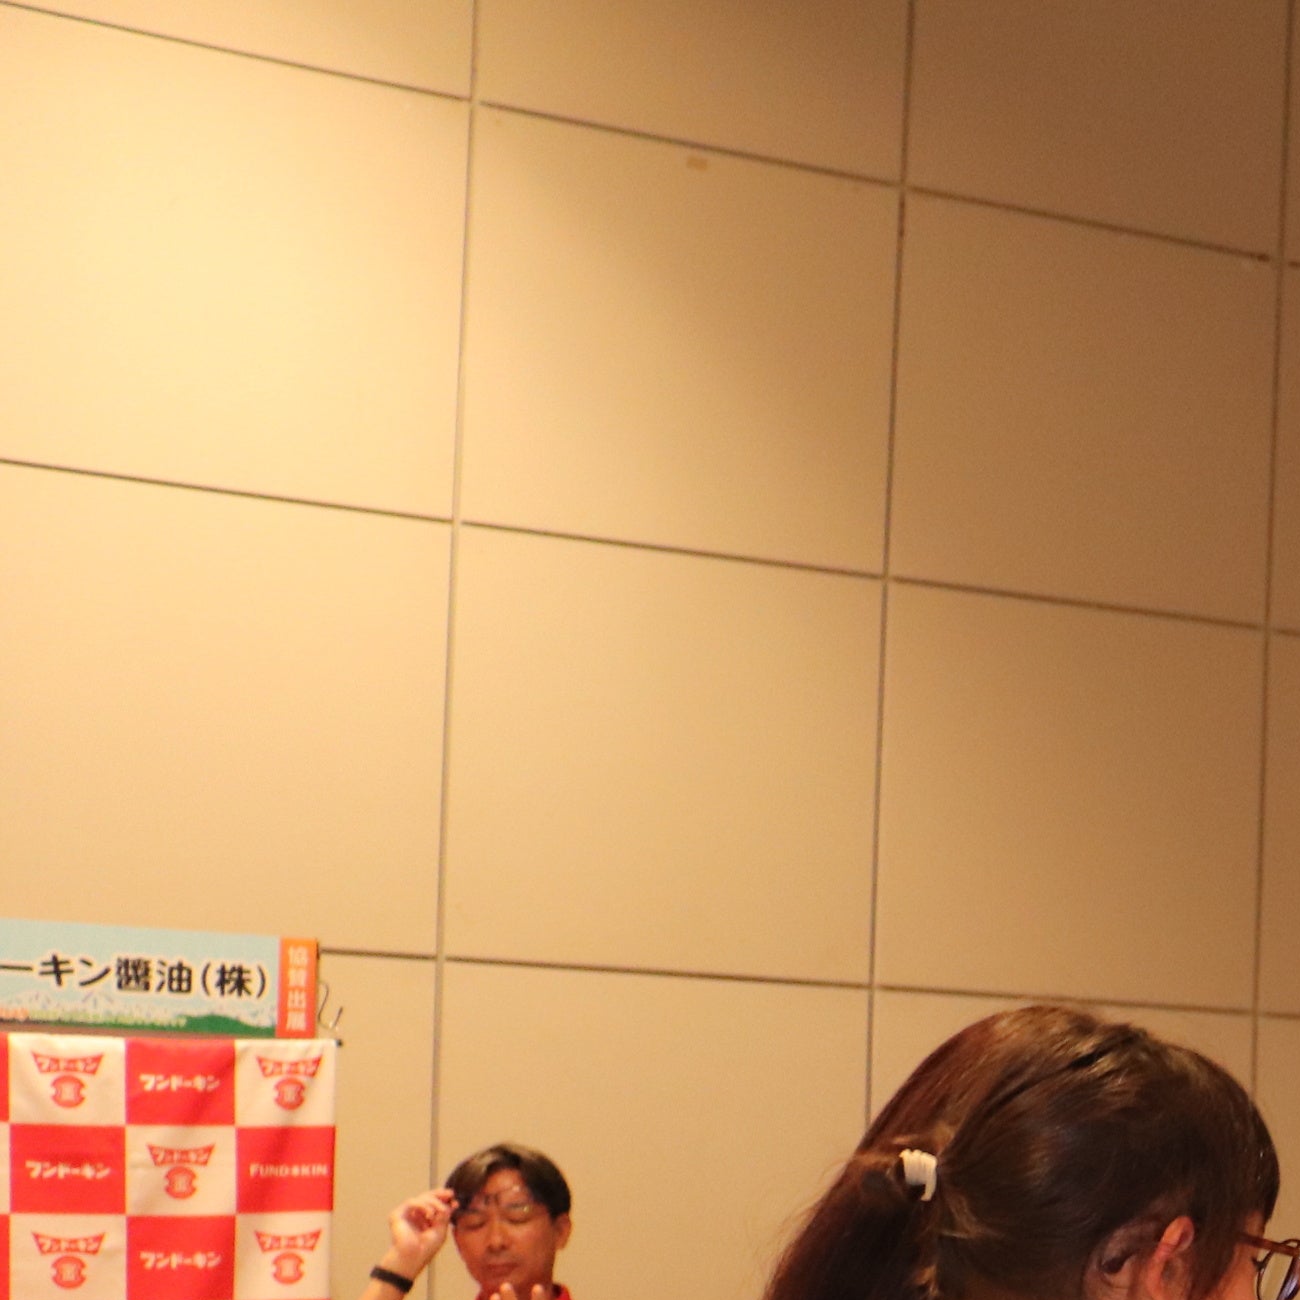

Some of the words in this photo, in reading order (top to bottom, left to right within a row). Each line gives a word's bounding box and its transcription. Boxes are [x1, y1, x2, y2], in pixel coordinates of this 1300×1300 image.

[140, 1073, 221, 1092] フンドーキン
[25, 1159, 112, 1180] フンドーキン
[140, 1251, 222, 1270] フンドーキン
